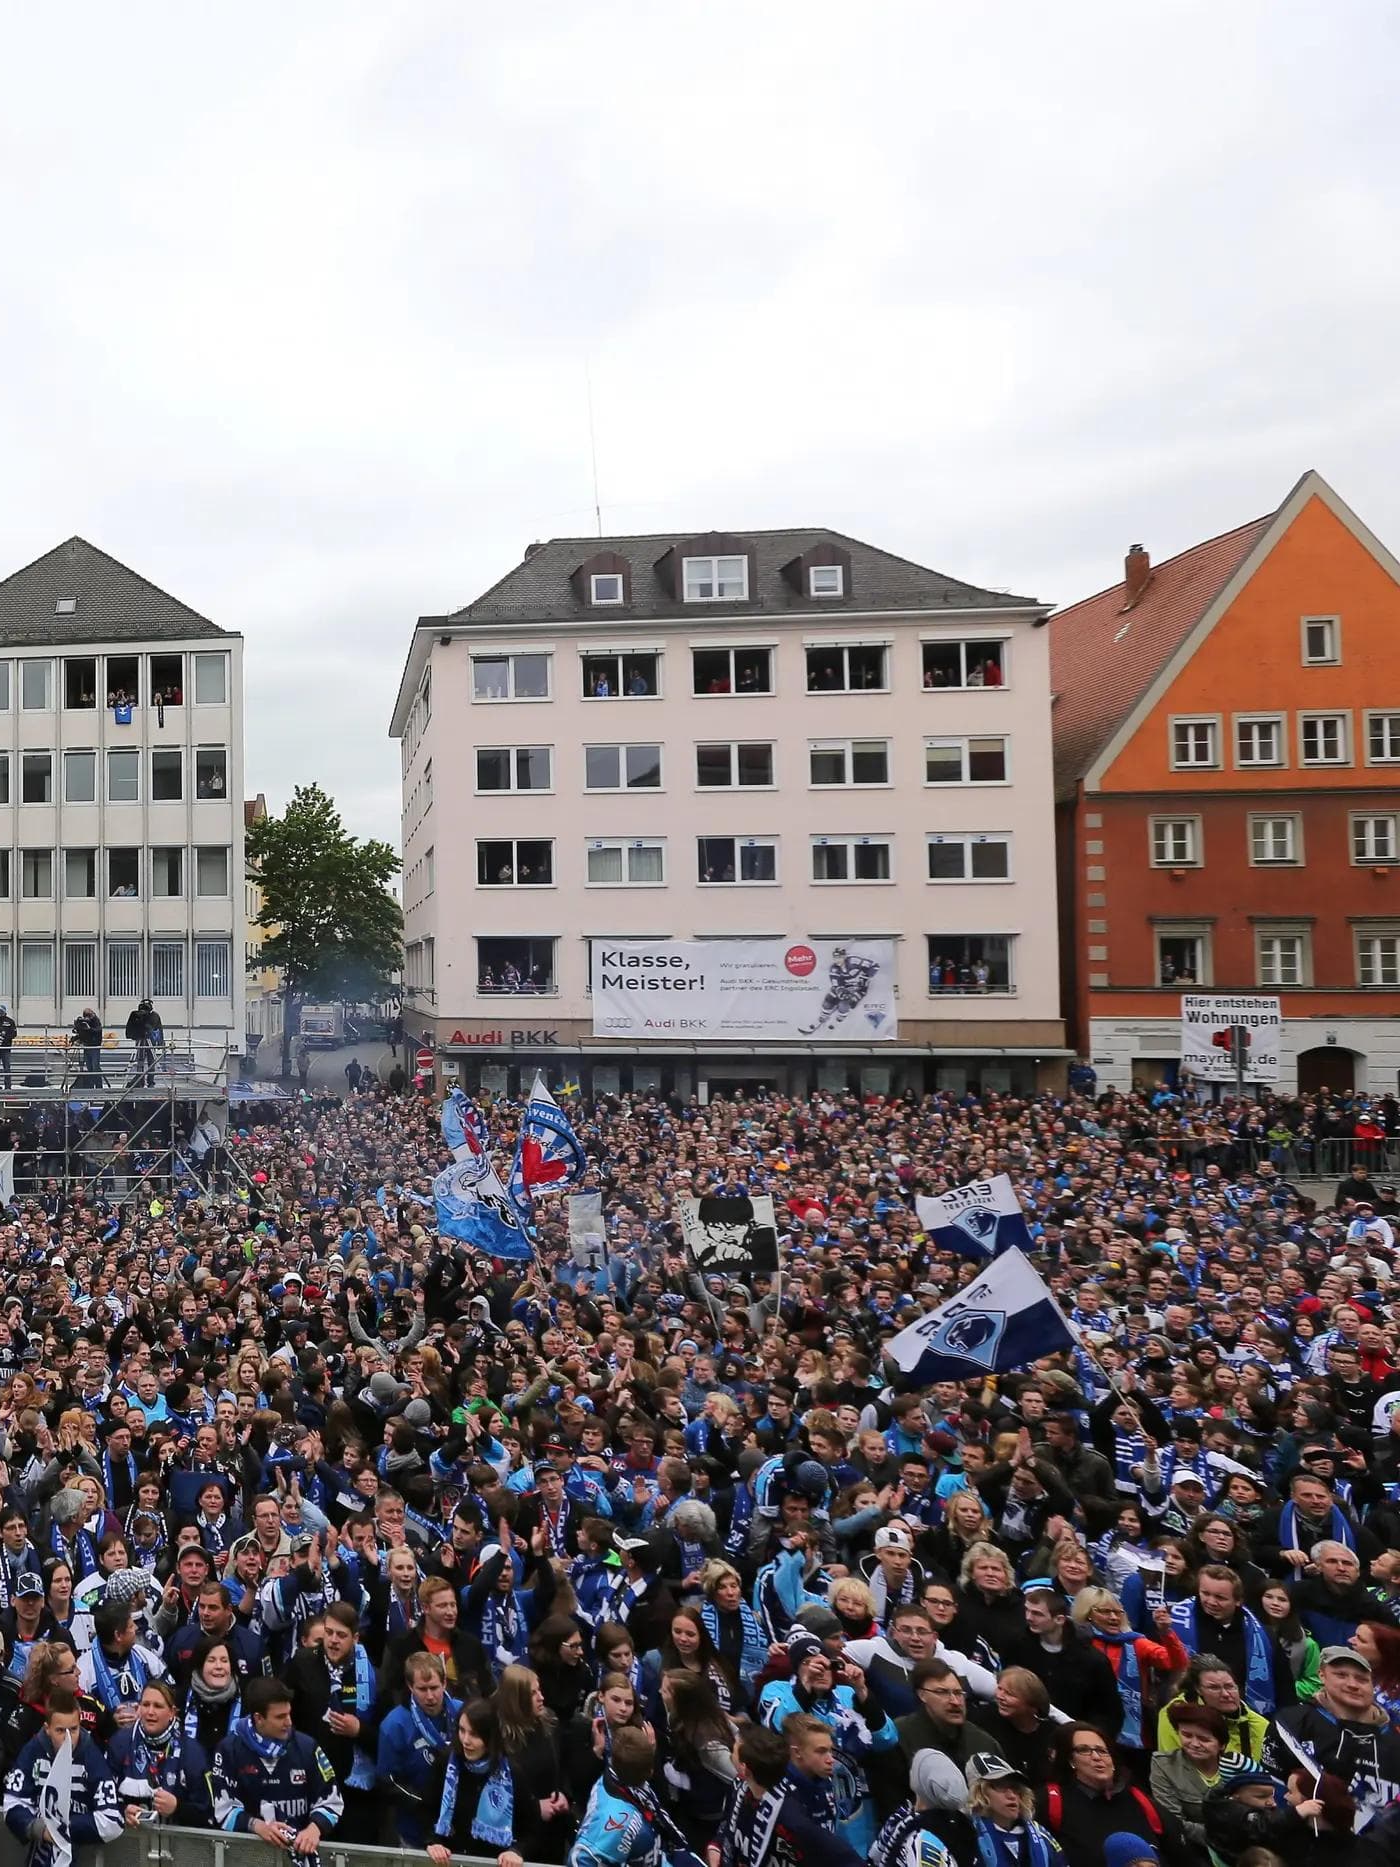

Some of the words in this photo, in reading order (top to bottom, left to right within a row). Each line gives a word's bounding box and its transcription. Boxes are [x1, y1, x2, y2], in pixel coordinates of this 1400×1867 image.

[601, 951, 691, 971] Klasse,
[601, 973, 705, 991] Meister!
[1184, 997, 1211, 1008] Hier
[1215, 998, 1278, 1009] entstehen
[644, 1018, 676, 1029] Audi
[680, 1018, 708, 1029] BKK
[1186, 1010, 1279, 1028] Wohnungen
[450, 1029, 504, 1045] Audi
[510, 1029, 560, 1045] BKK
[1183, 1053, 1278, 1066] mayrbu.de
[93, 1779, 118, 1806] 43
